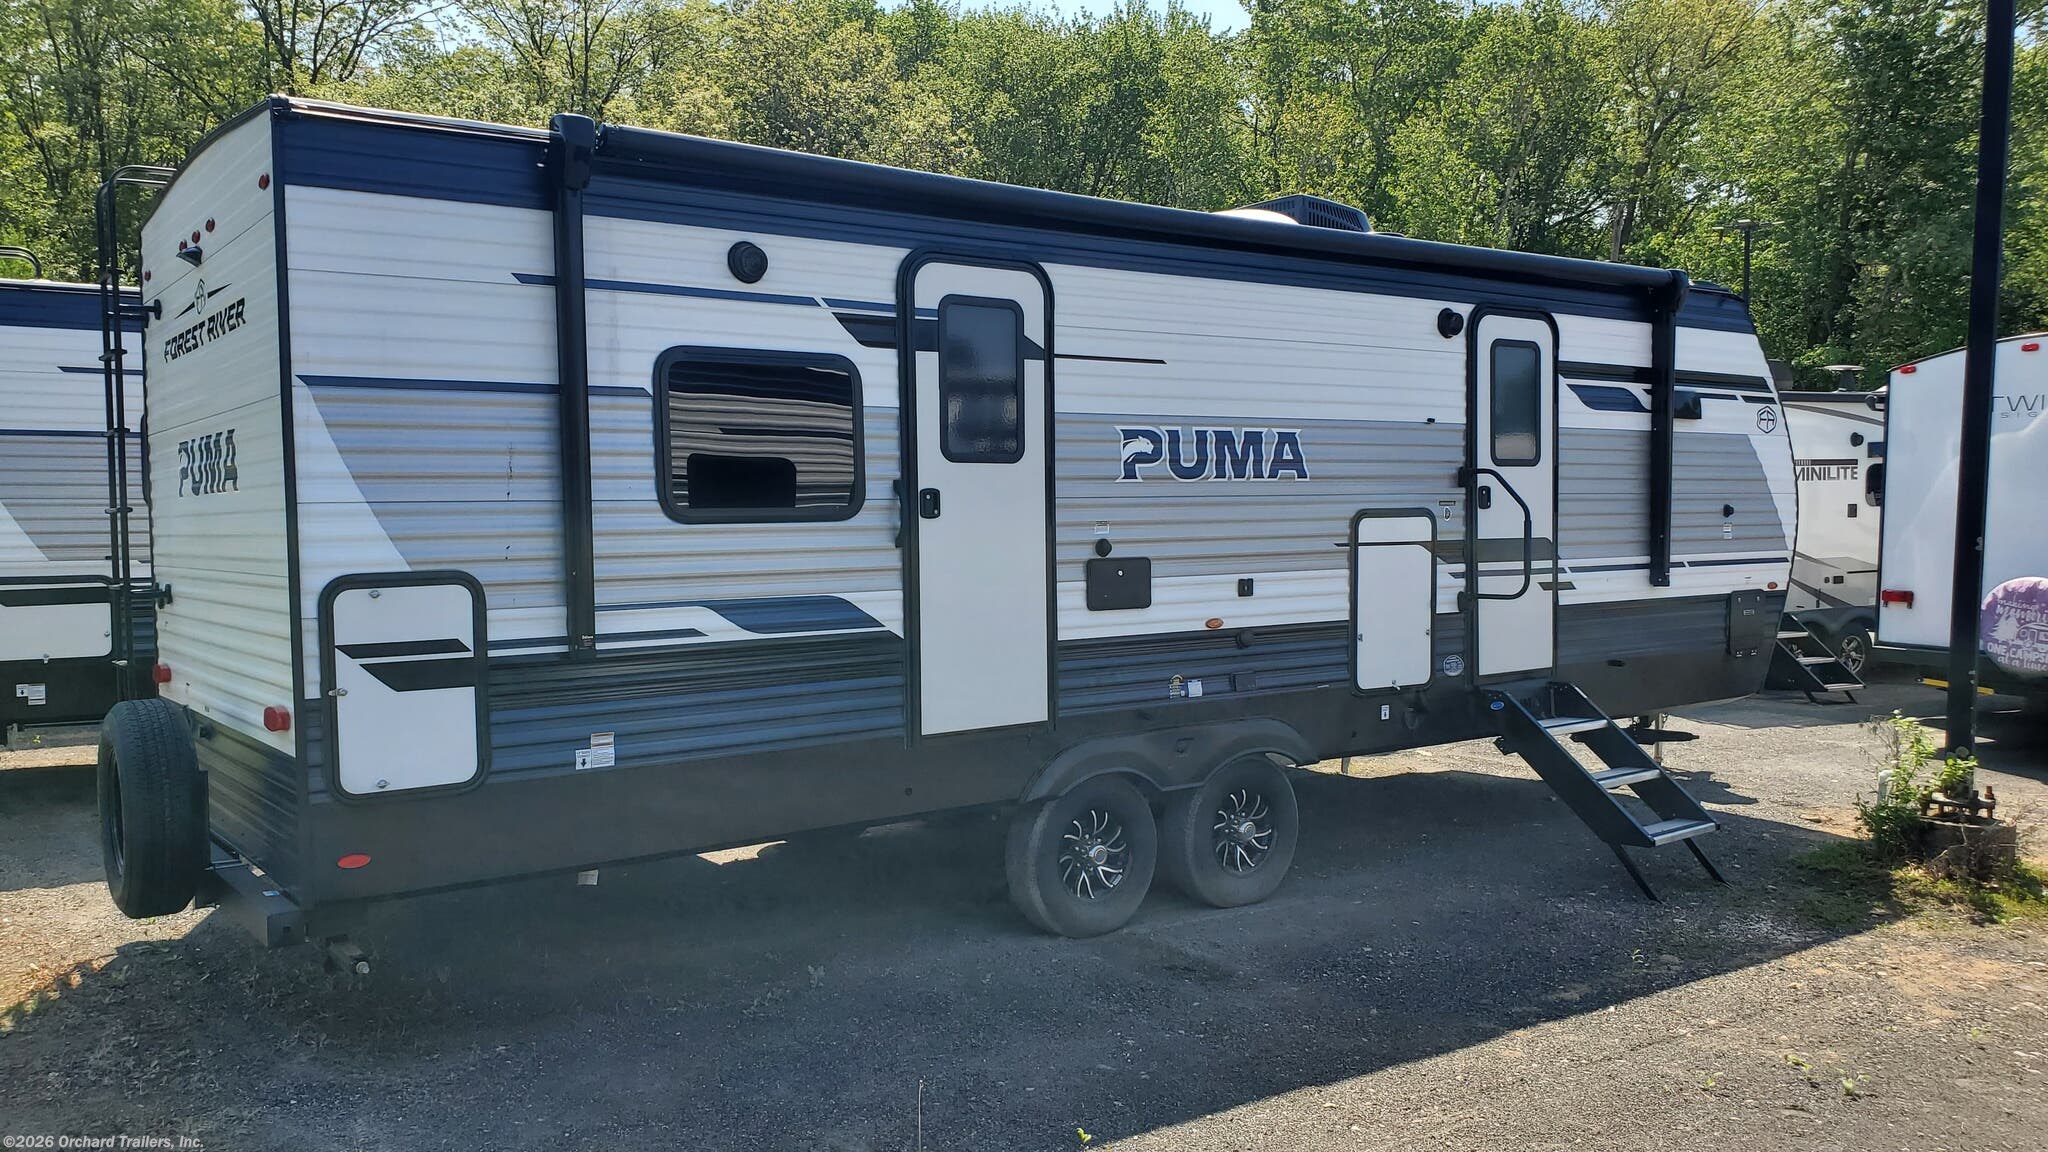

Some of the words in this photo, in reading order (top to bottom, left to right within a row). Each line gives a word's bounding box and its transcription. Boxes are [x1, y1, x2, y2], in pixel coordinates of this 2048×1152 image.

[163, 319, 207, 363] FOREST
[206, 297, 247, 342] RIVER
[178, 428, 239, 498] PUMA
[1114, 425, 1310, 483] PUMA
[1987, 642, 2008, 656] ONE
